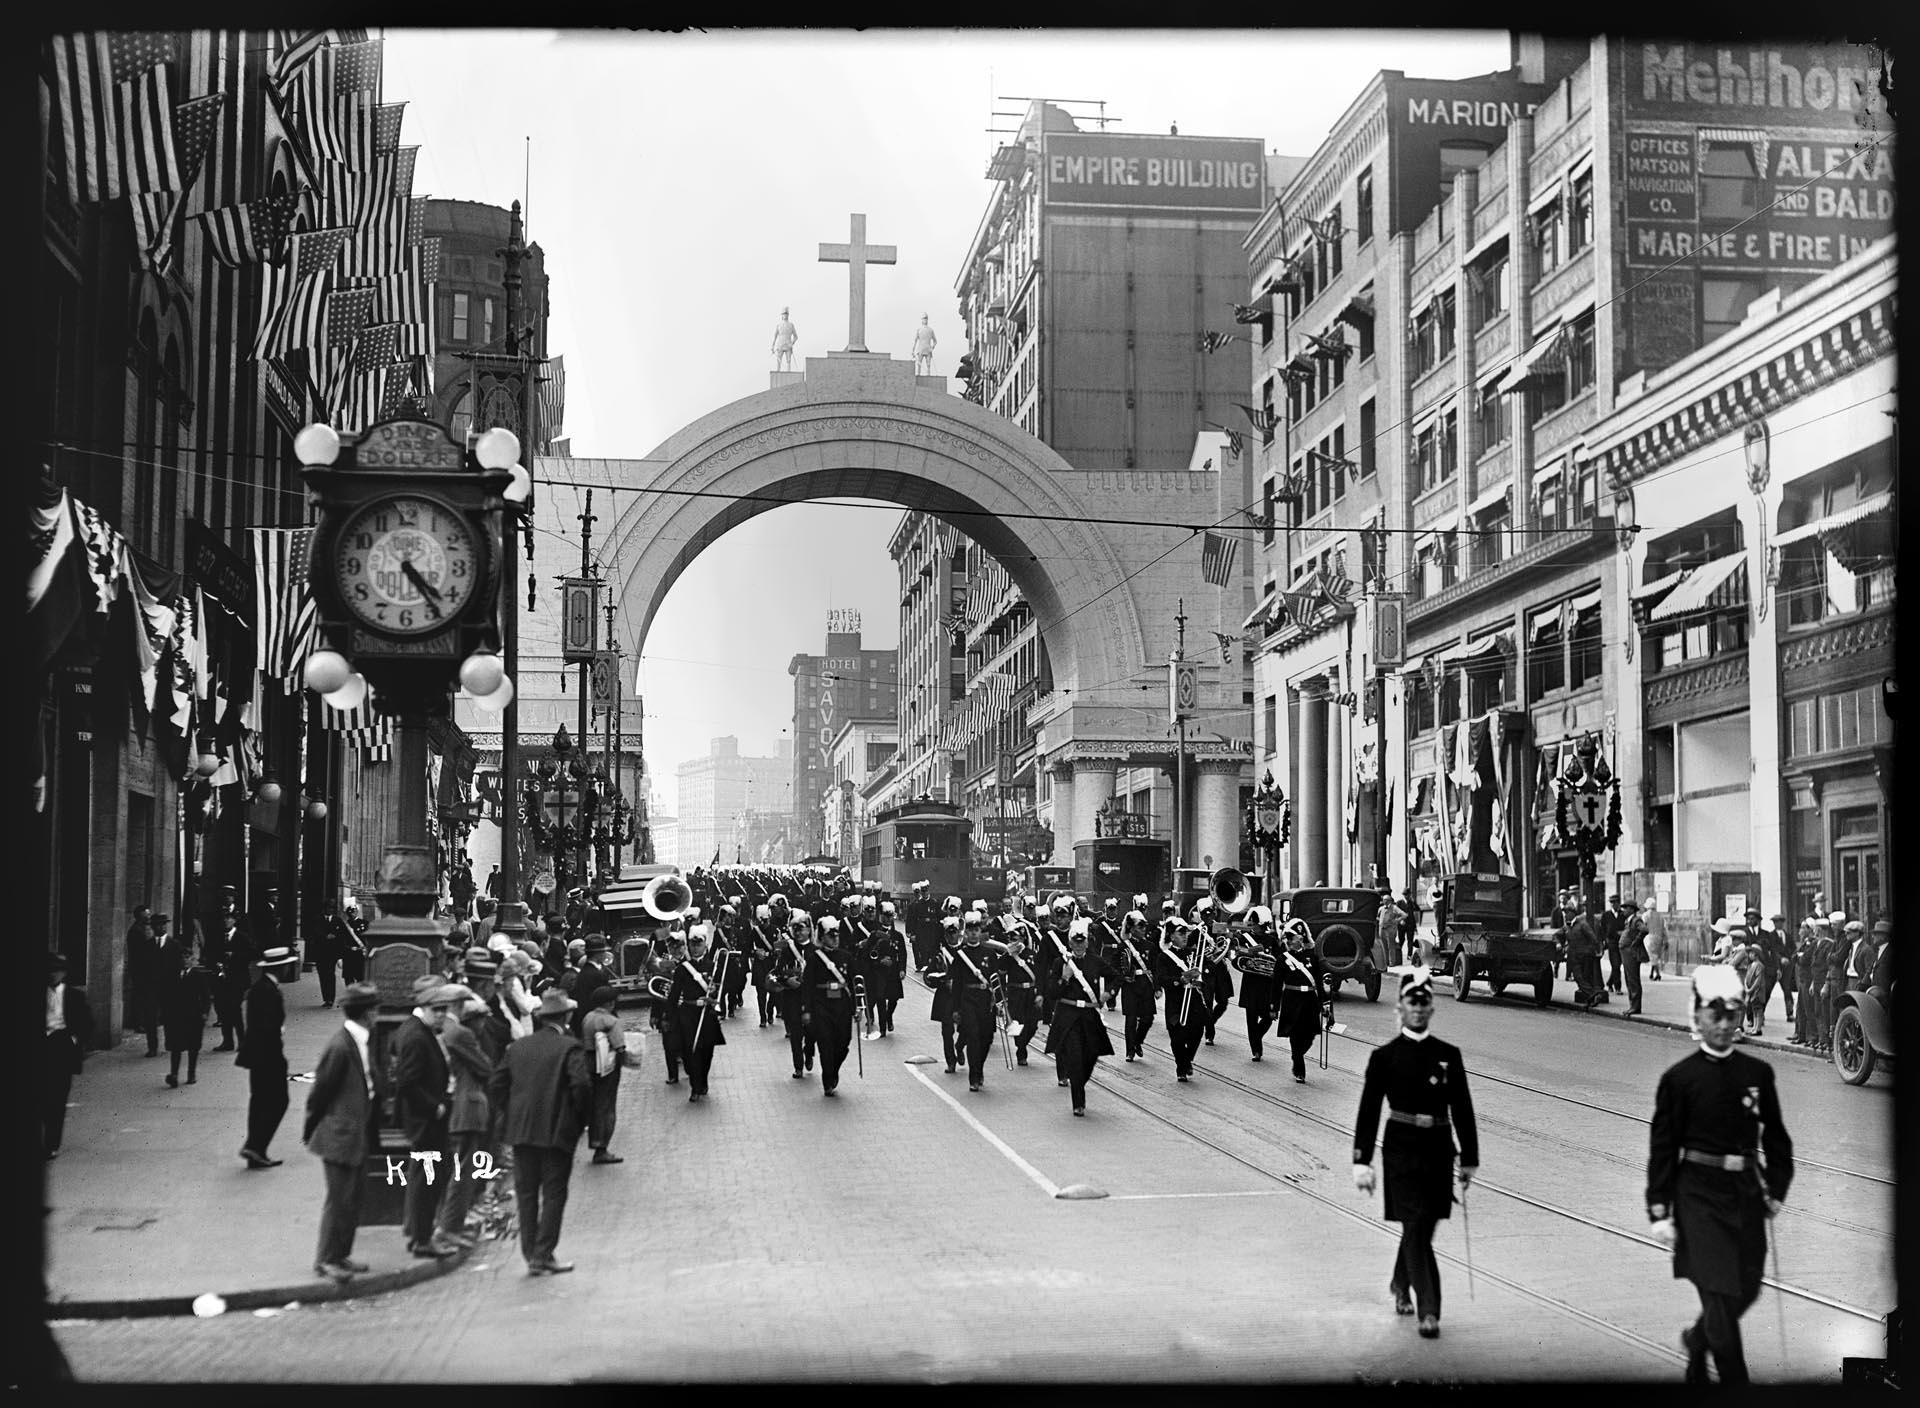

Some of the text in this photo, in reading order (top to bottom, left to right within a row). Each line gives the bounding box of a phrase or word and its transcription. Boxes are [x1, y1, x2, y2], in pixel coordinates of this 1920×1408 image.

[1408, 98, 1519, 127] MARION
[1630, 138, 1689, 155] OFFICES
[1050, 155, 1259, 189] EMPIRE BUILDING
[1629, 156, 1690, 174] MATSON
[1775, 145, 1895, 181] ALEXA
[1629, 176, 1694, 194] NAVIGATION
[1649, 197, 1677, 213] CO.
[1772, 186, 1894, 220] AND BALD
[1638, 228, 1737, 257] MARINE
[1744, 234, 1761, 257] &
[1769, 231, 1832, 261] FIRE
[382, 425, 438, 441] DIME
[367, 450, 449, 464] DOLLAR
[375, 514, 388, 532] 11
[431, 514, 437, 532] 1
[354, 532, 373, 550] 10
[447, 533, 463, 551] 2
[347, 558, 361, 576] 9
[452, 559, 466, 577] 3
[355, 582, 369, 601] 8
[444, 586, 460, 603] 4
[375, 603, 389, 620] 7
[399, 609, 413, 627] 6
[822, 659, 858, 670] HOTEL
[819, 671, 834, 768] SAVOY
